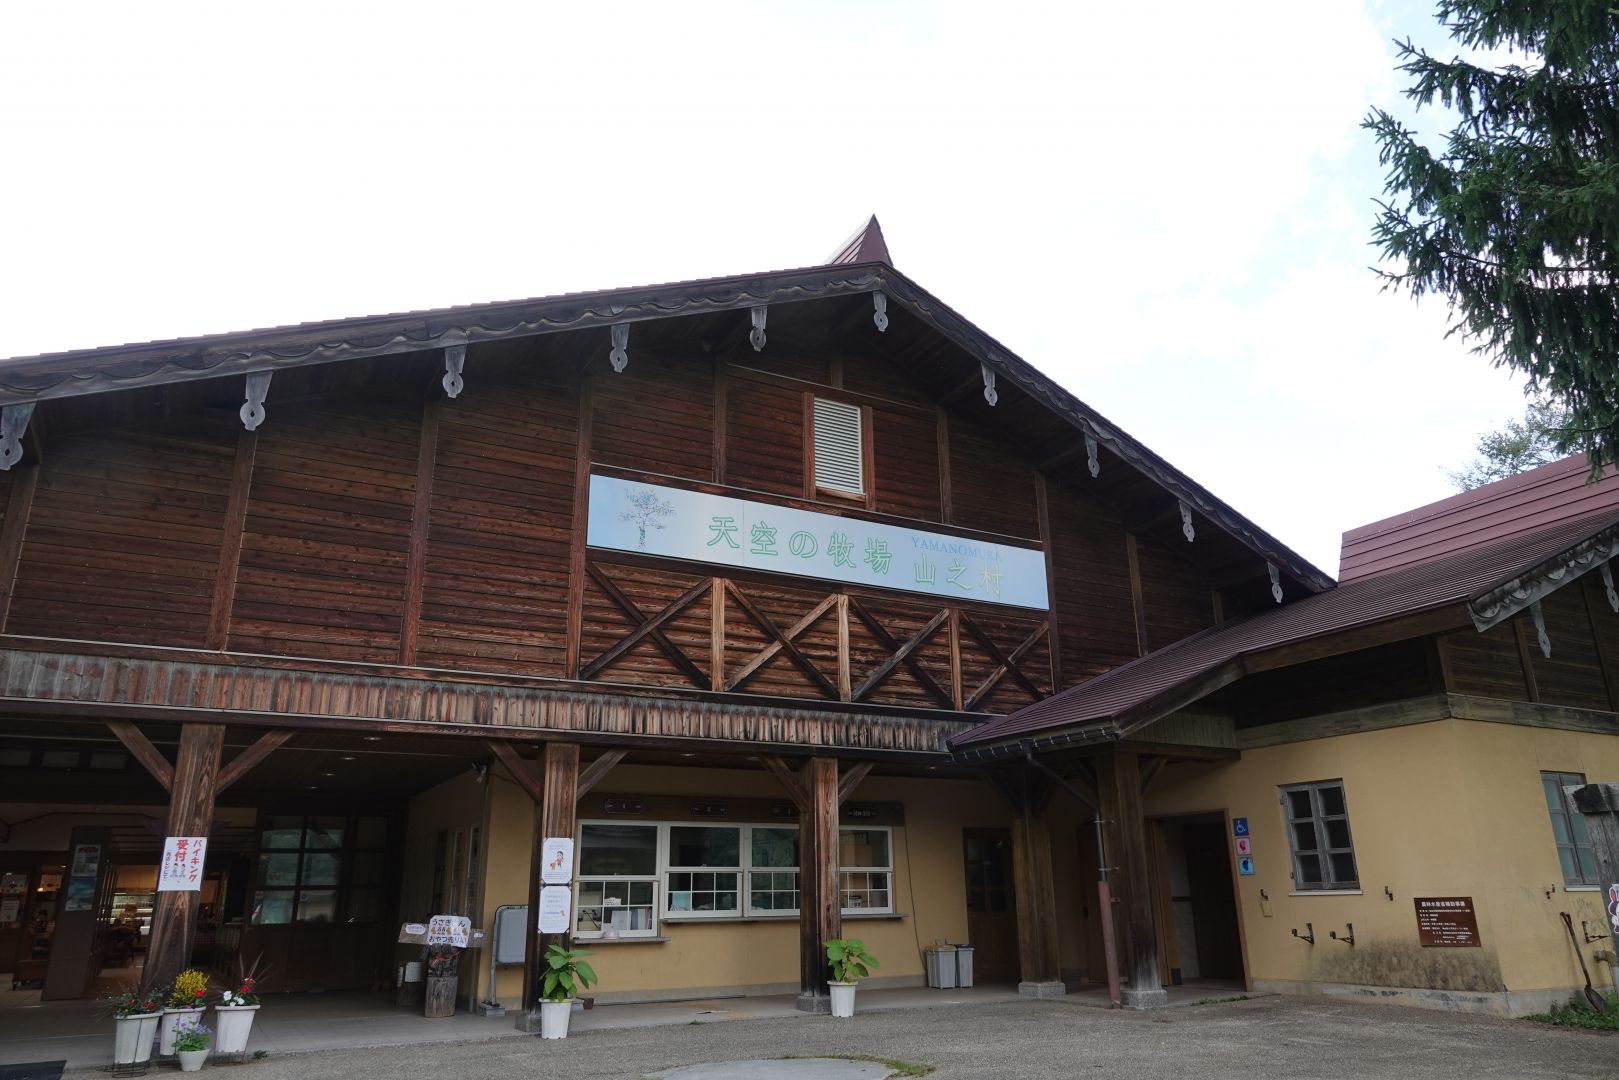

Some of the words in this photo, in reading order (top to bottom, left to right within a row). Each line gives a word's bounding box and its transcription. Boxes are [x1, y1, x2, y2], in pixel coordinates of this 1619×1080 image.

[707, 516, 892, 575] 天空の牧場
[911, 535, 1002, 561] YAMANOMURA
[913, 553, 1004, 599] 山之村
[175, 839, 189, 862] 受付
[188, 839, 203, 883] バイキング
[432, 919, 466, 928] うさぎん
